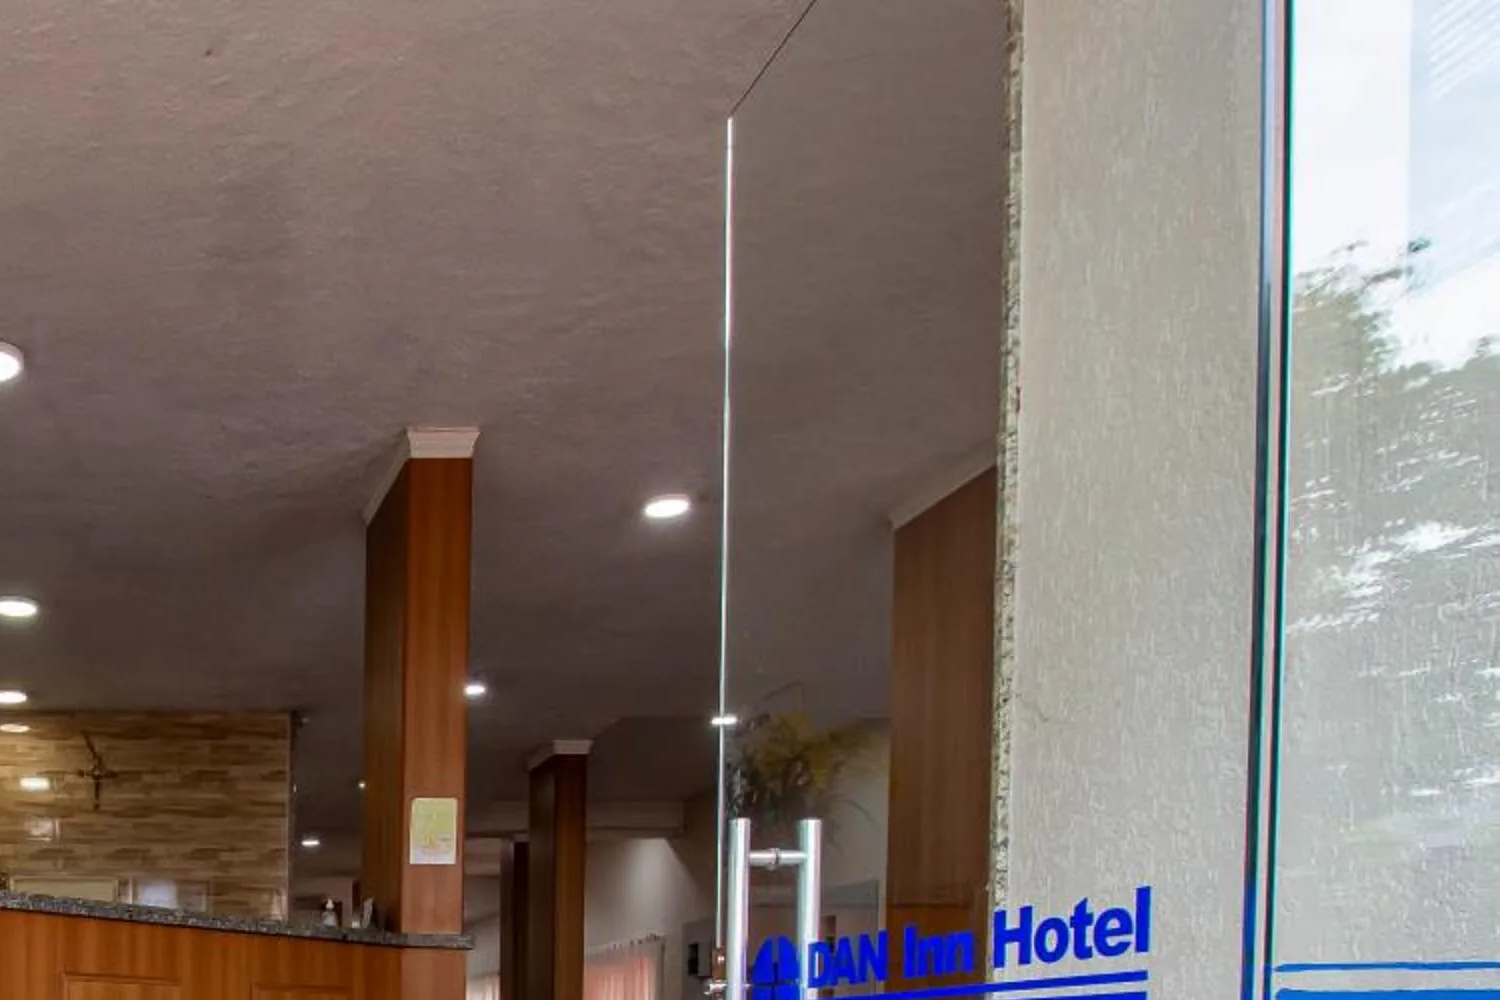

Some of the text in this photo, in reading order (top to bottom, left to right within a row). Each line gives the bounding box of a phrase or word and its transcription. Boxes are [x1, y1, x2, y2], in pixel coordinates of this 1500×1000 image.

[808, 885, 1151, 988] DAN Inn Hotel
